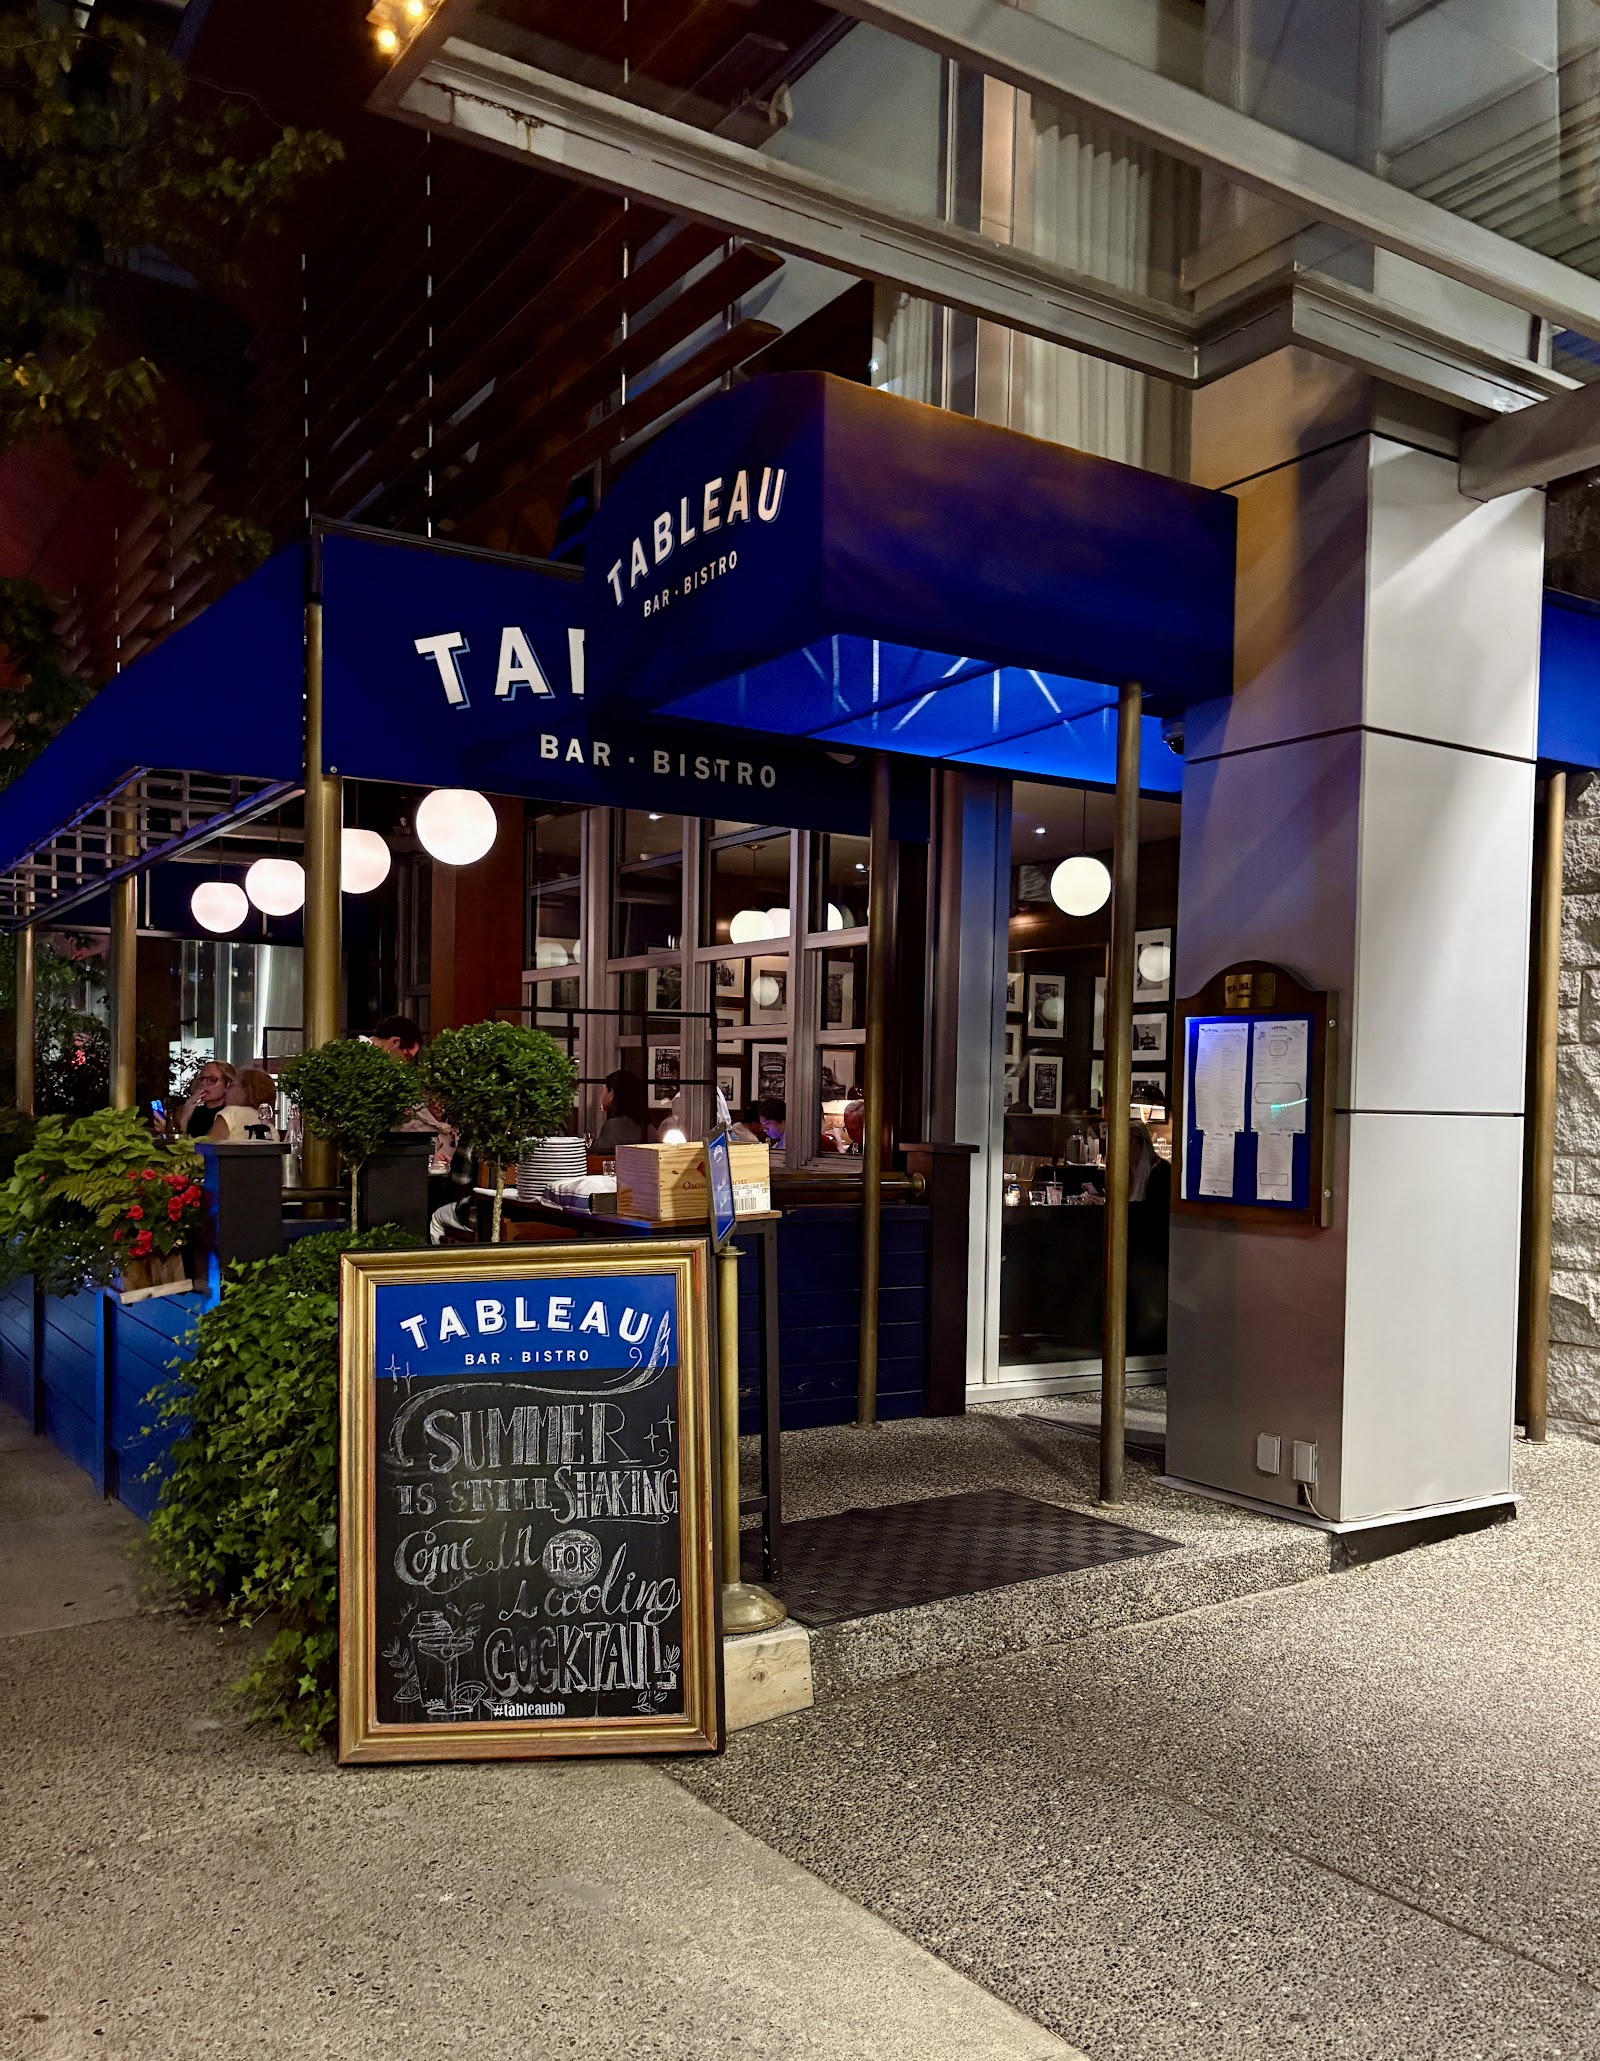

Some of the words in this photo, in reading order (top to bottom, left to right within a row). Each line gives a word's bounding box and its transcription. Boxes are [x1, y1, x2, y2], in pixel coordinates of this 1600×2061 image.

[607, 466, 787, 607] TABLEAU
[643, 588, 670, 618] BAR
[683, 550, 738, 595] BISTRO
[540, 733, 611, 767] BAR
[653, 750, 777, 789] BISTRO
[400, 1296, 654, 1351] TABLEAU
[464, 1352, 501, 1365] BAR
[521, 1349, 590, 1364] BISTRO
[423, 1402, 643, 1474] SUMMER
[395, 1482, 437, 1516] IS
[550, 1465, 679, 1524] SHAKING
[543, 1542, 681, 1626] cooling
[549, 1542, 597, 1574] FOR
[483, 1621, 678, 1698] COCKTAIL
[493, 1701, 566, 1718] #tableaubb
